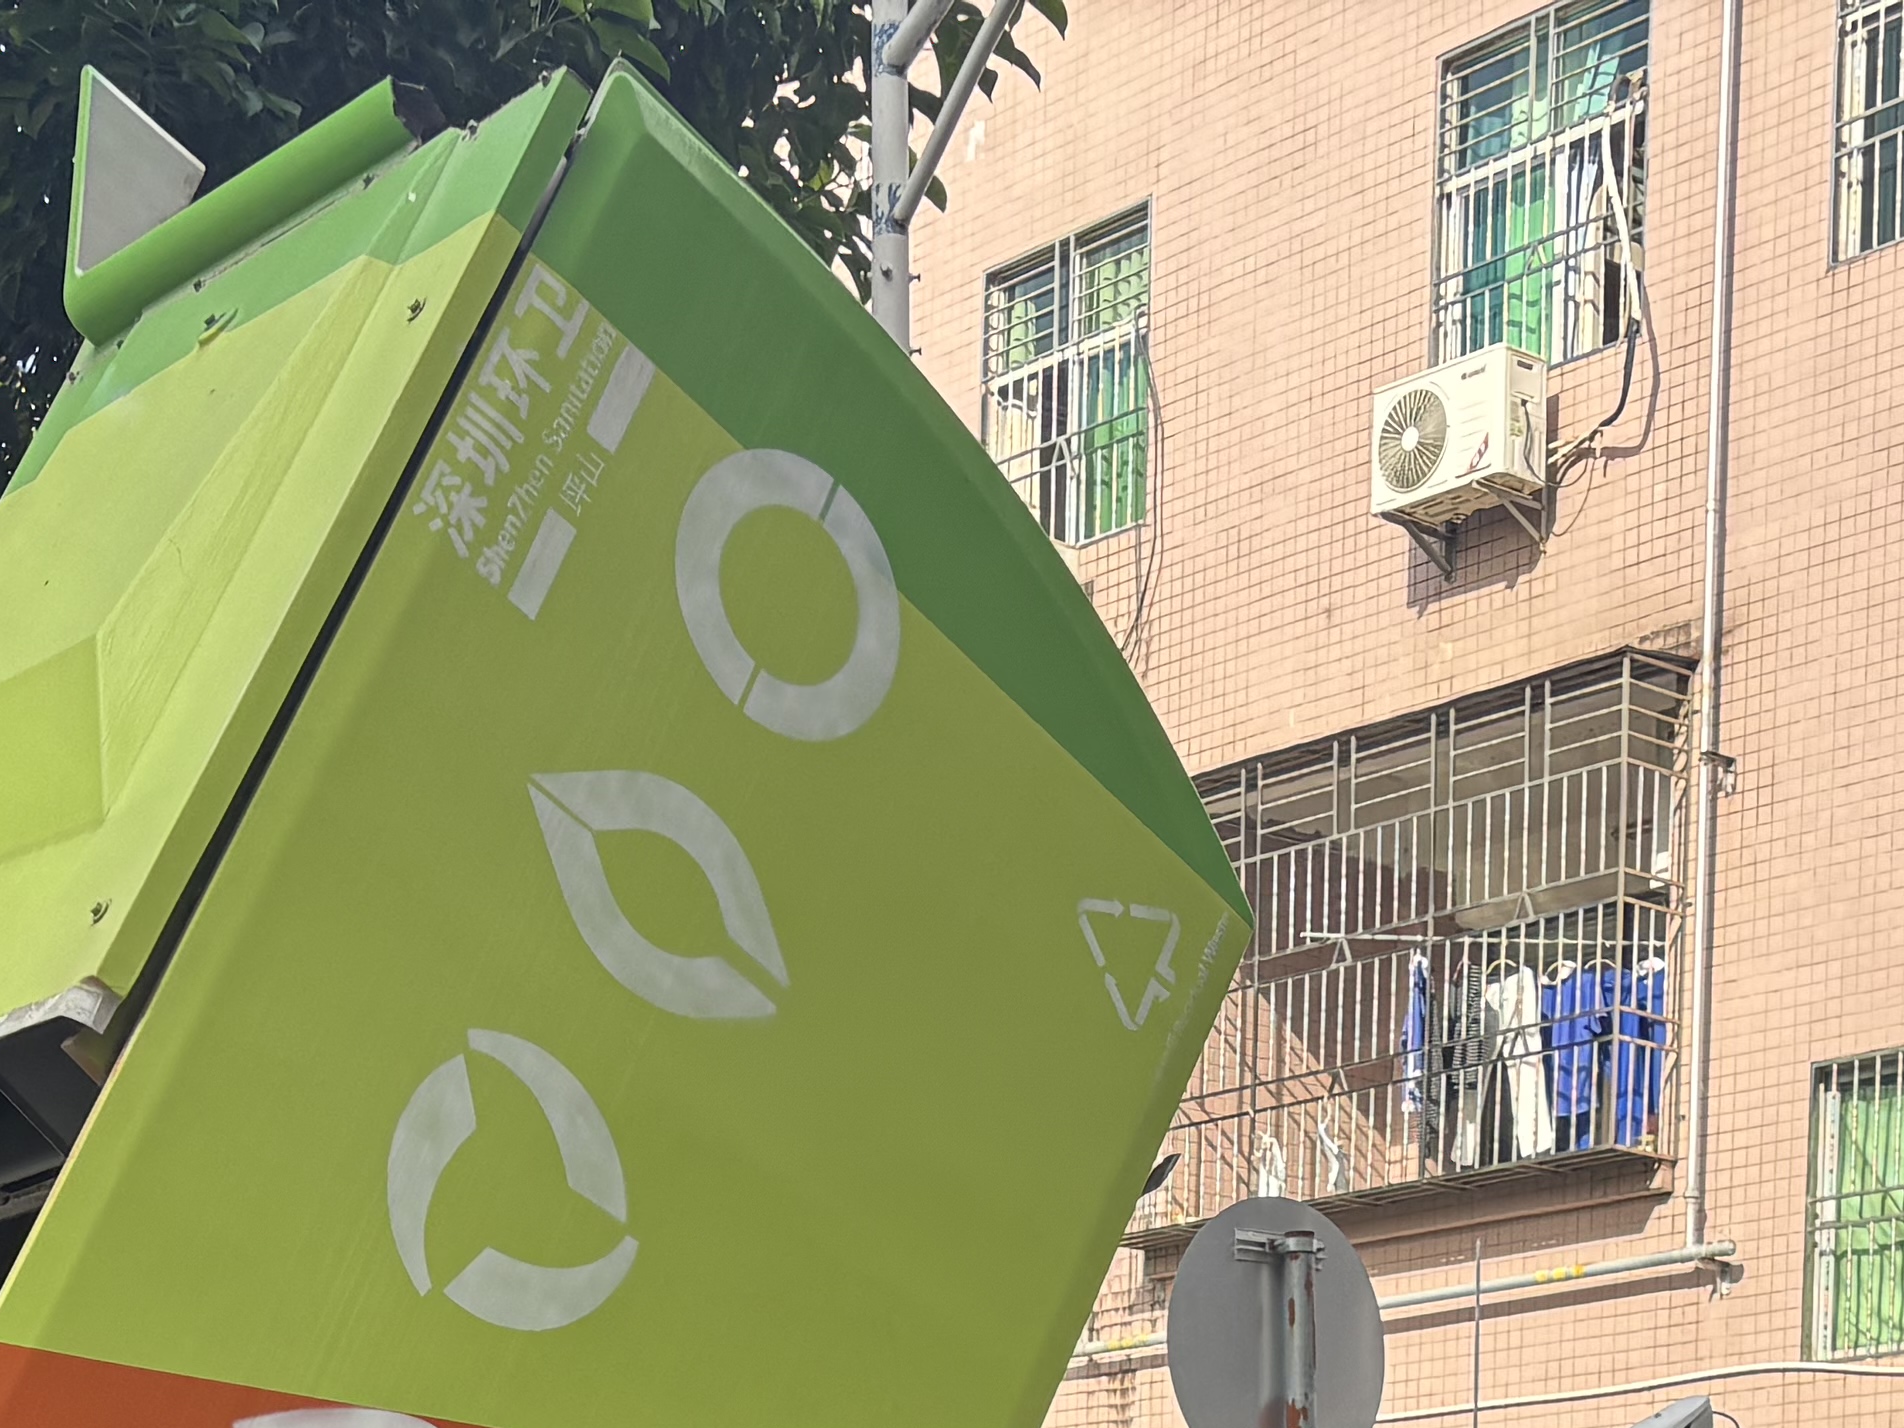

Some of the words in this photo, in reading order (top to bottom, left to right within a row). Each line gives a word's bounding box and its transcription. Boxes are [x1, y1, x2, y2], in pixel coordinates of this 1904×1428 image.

[413, 264, 590, 559] 深圳环卫
[475, 453, 552, 587] ShenZhen
[542, 320, 618, 453] Sanitation
[558, 451, 605, 517] 坪山
